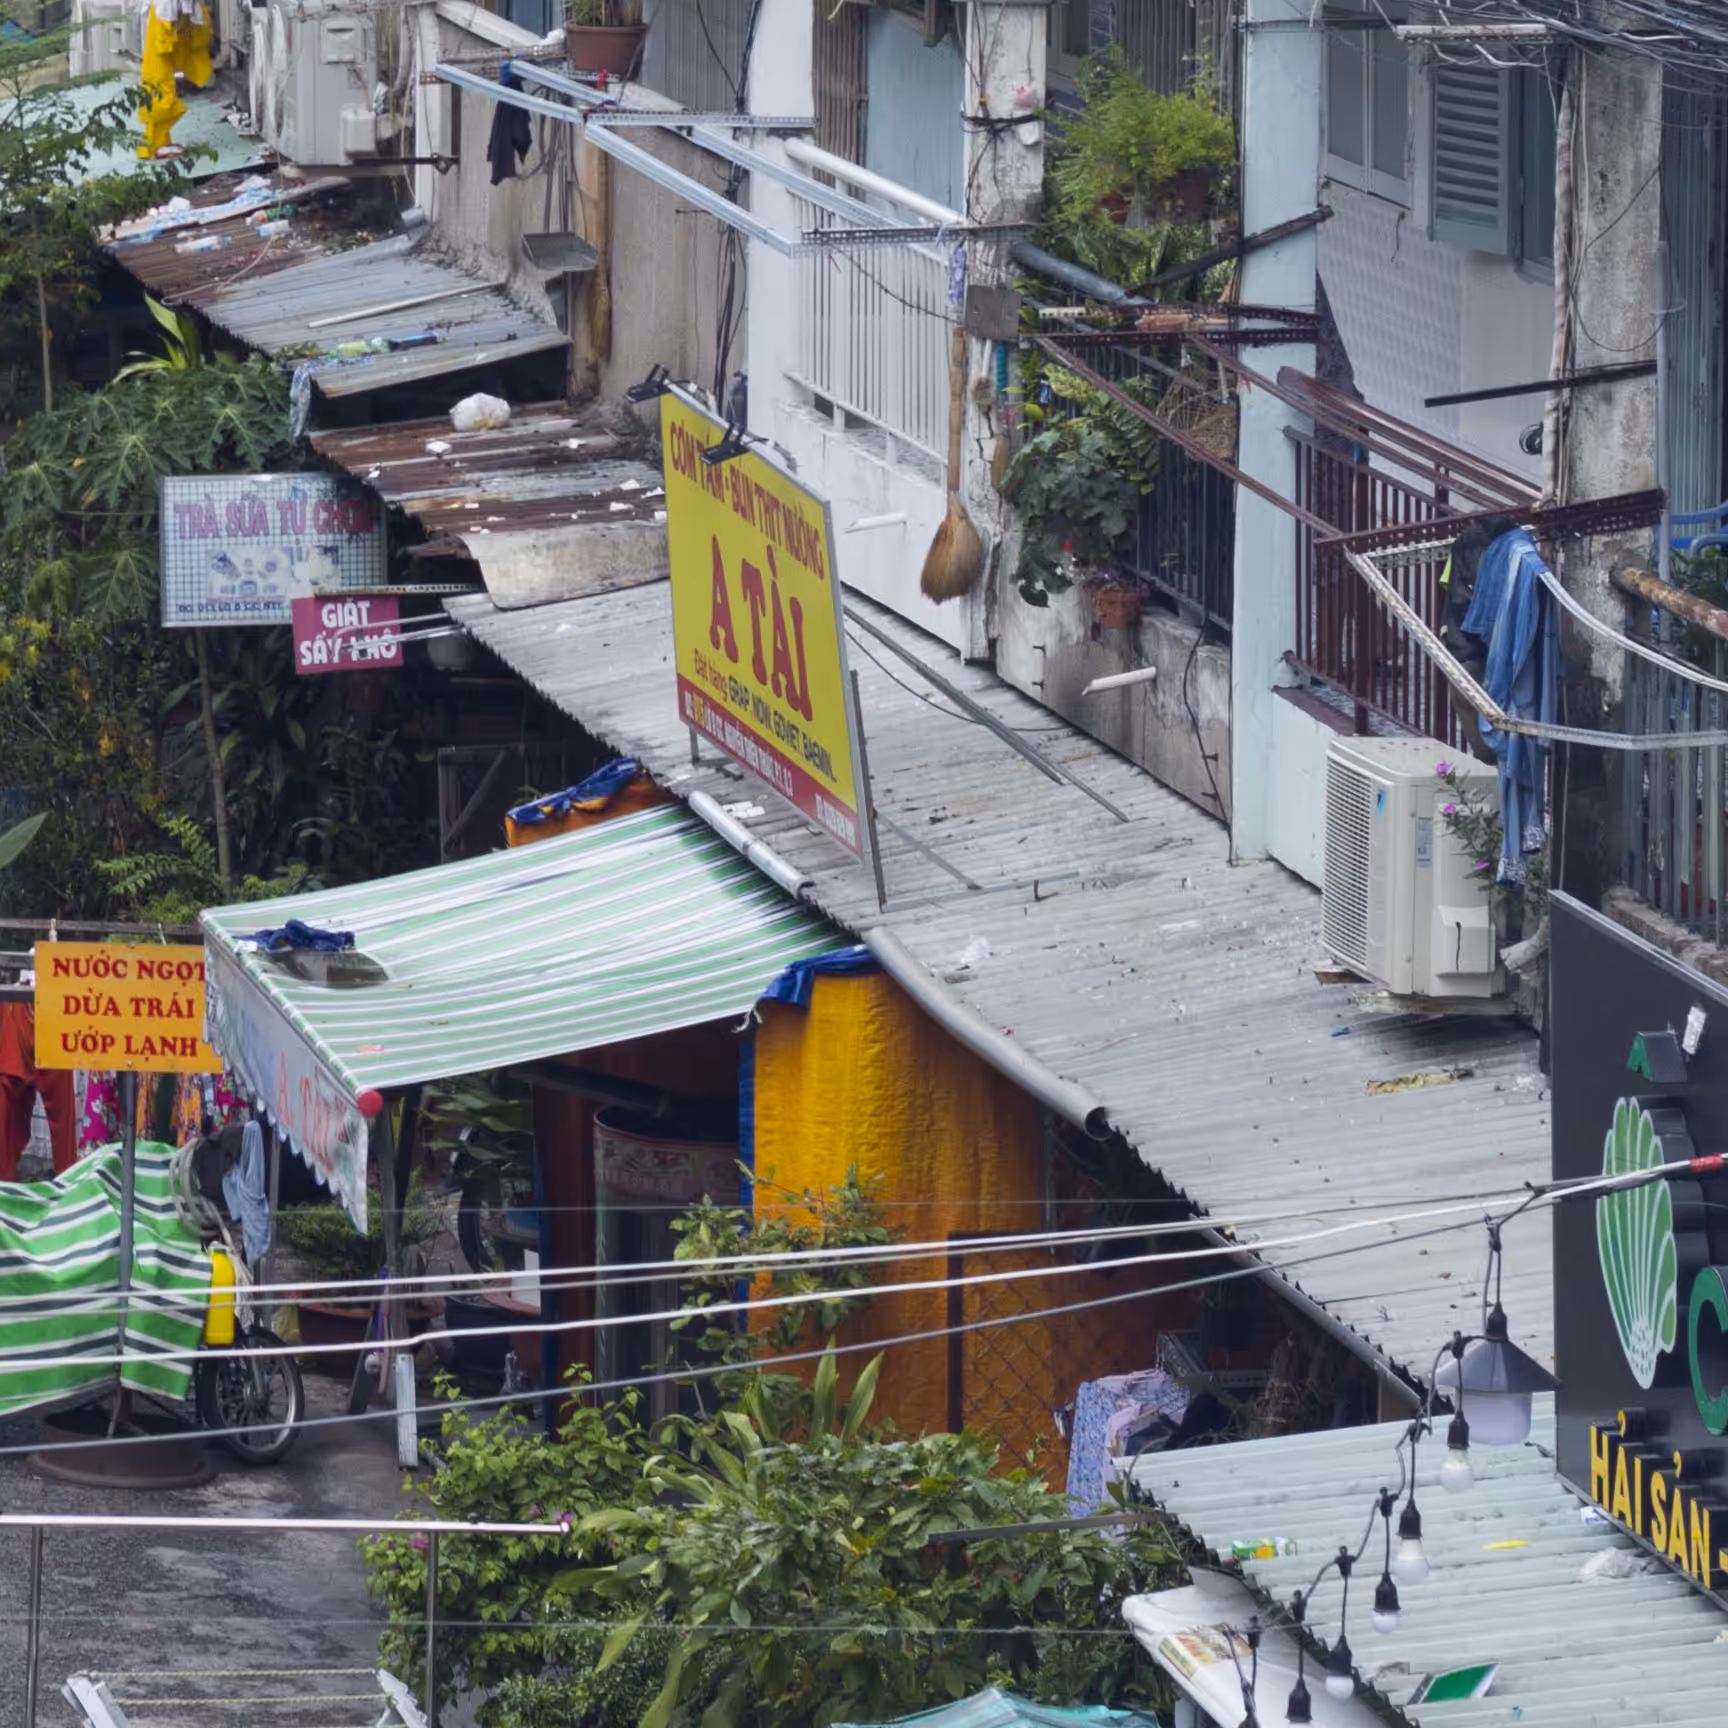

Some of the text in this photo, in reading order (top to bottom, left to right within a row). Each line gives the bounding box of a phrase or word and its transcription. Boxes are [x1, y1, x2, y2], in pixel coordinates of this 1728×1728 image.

[670, 419, 697, 484] CƠM
[175, 493, 220, 540] TRÀ
[225, 490, 270, 538] SỮA
[299, 629, 344, 666] SẤY
[709, 534, 814, 722] A TÀI
[52, 948, 208, 988] NƯỚC NGỌT
[62, 991, 196, 1020] DỪA TRÁI
[61, 1024, 198, 1063] ƯỚP LẠNH
[1590, 1409, 1642, 1537] HẢI
[1650, 1449, 1712, 1590] SẢN
